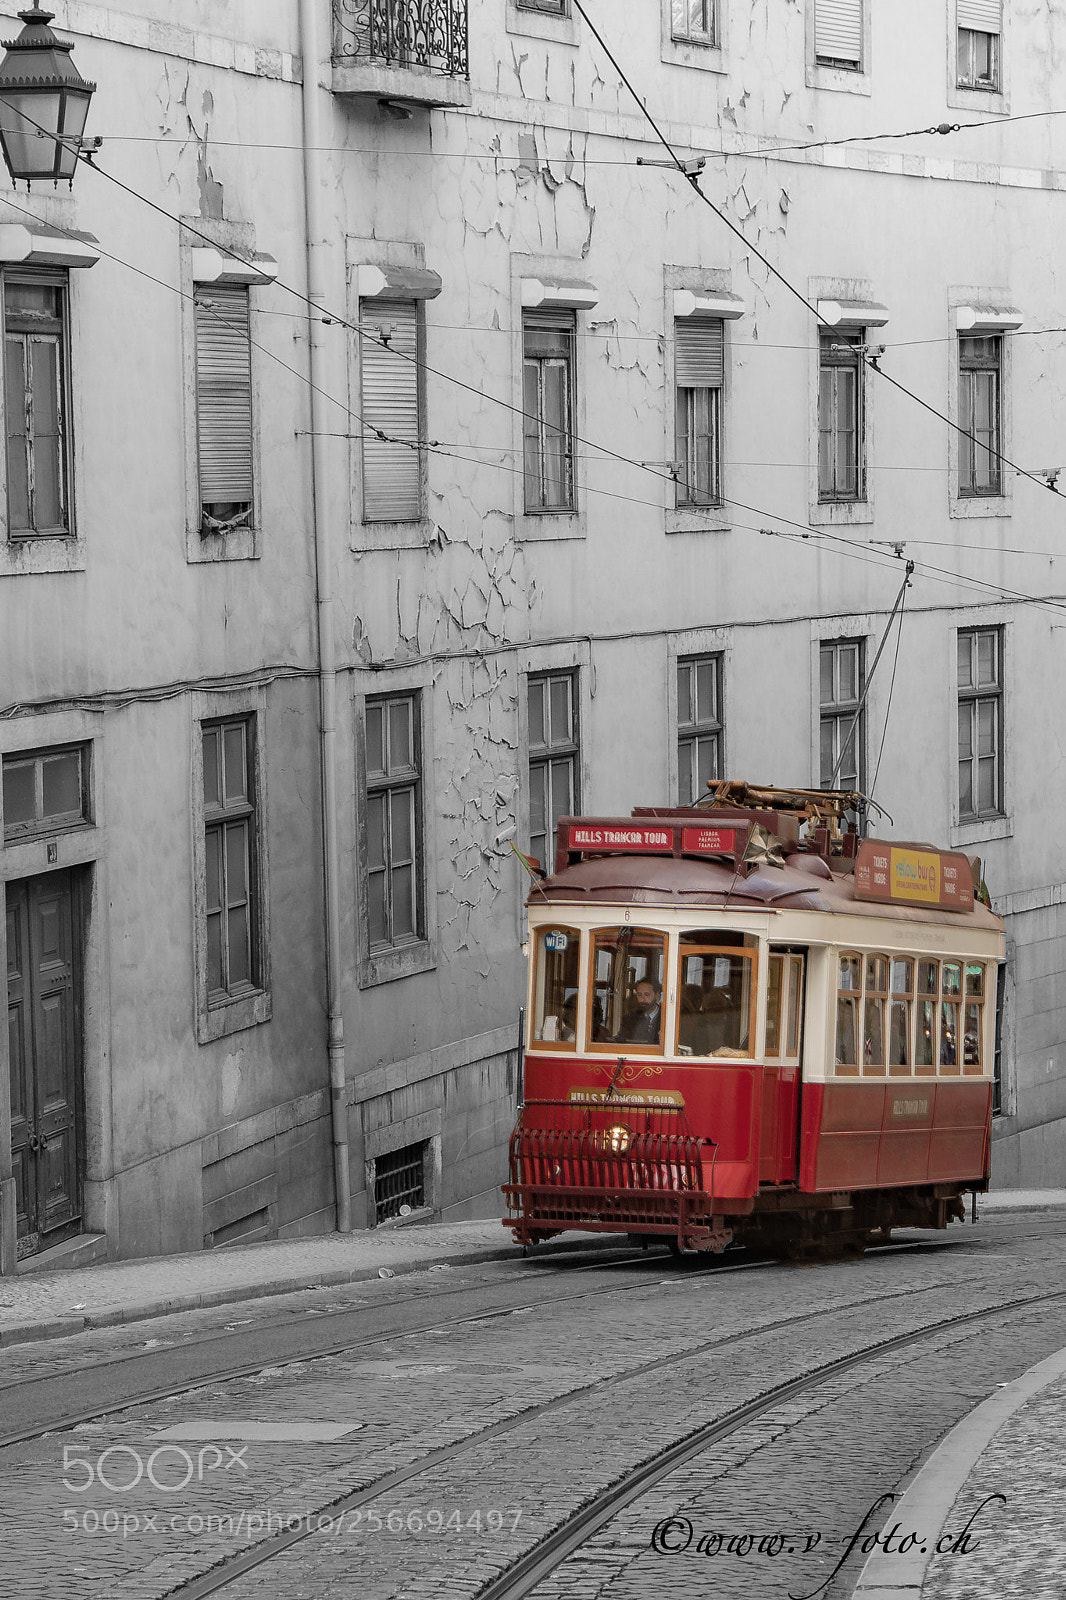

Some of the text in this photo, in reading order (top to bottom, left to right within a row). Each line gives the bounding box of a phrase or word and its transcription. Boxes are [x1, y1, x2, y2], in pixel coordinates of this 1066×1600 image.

[575, 830, 602, 843] HILLS
[643, 831, 668, 845] TOUR
[624, 910, 630, 922] 6
